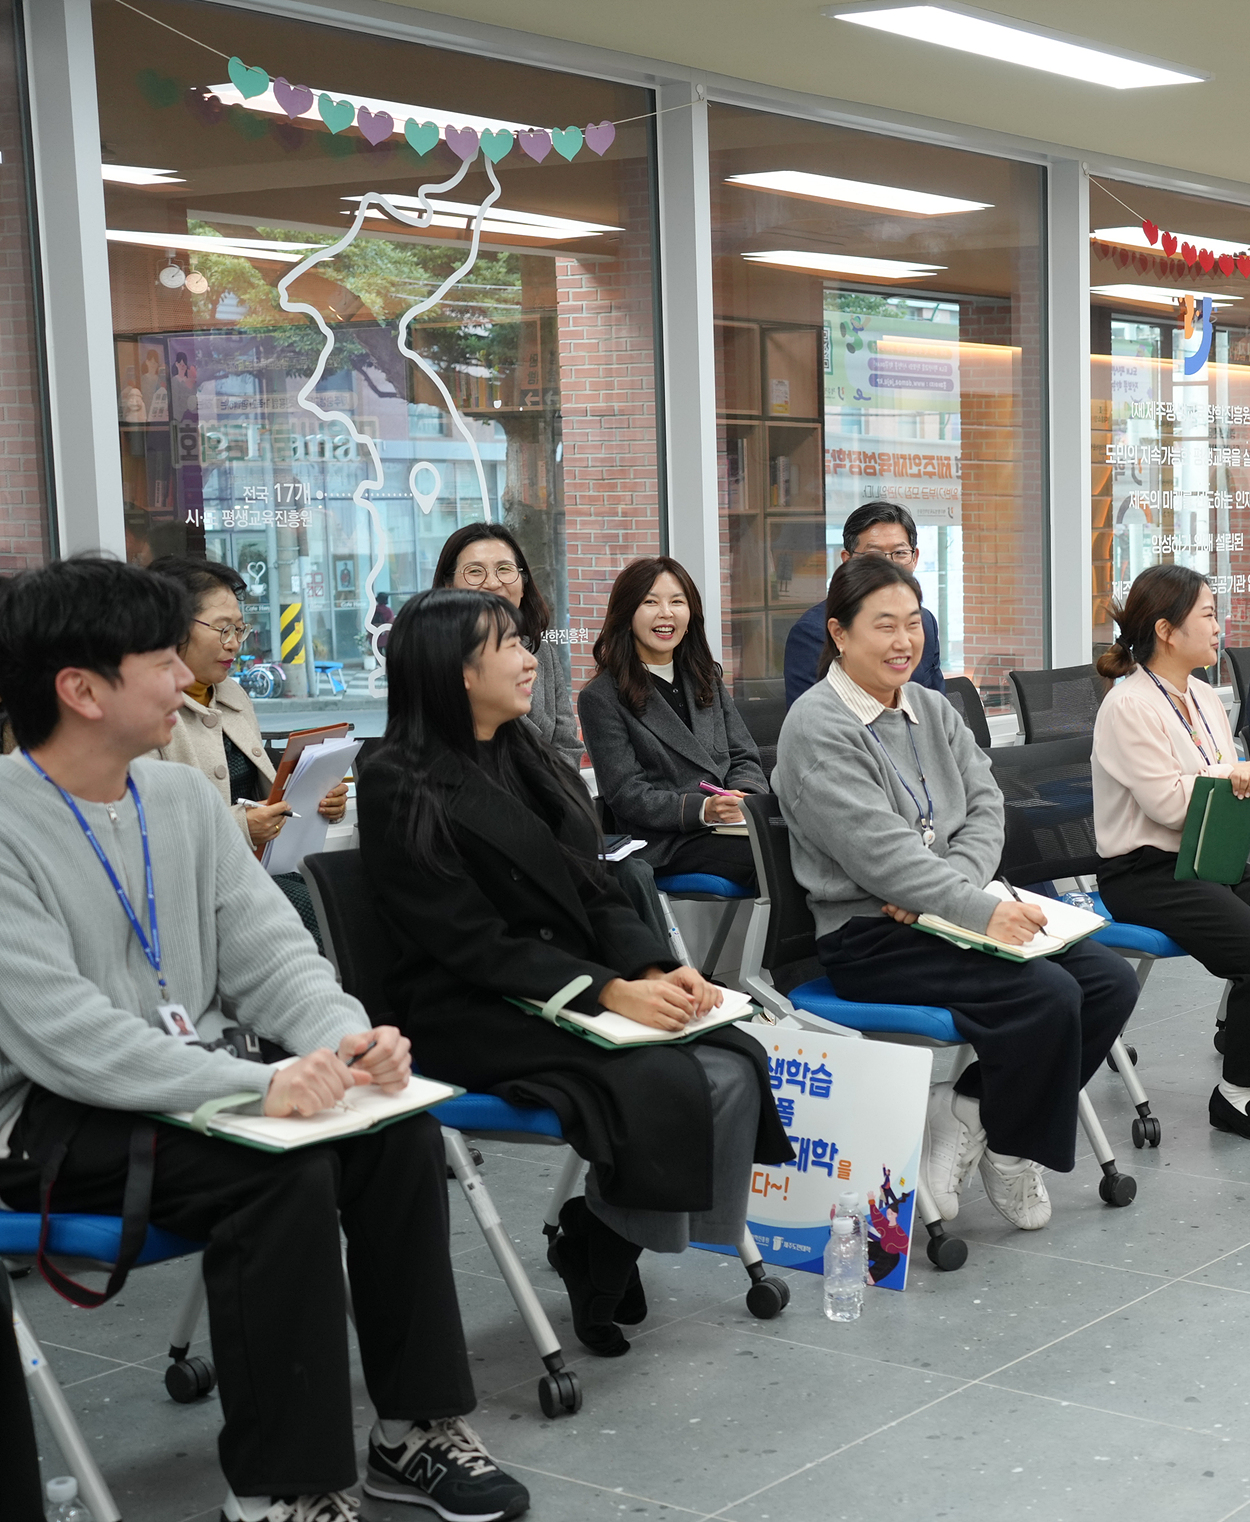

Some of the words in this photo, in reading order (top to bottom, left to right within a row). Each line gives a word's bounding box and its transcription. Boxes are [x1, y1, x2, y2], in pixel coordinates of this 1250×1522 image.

[1105, 444, 1138, 465] 도민의
[243, 486, 269, 504] 전국
[274, 482, 311, 505] 17개
[1129, 490, 1160, 510] 제주의
[221, 509, 313, 528] 평생교육진흥원
[1151, 535, 1191, 554] 양성하기
[1215, 532, 1244, 551] 설립된
[763, 1135, 852, 1181] 대학을
[405, 1452, 448, 1494] N
